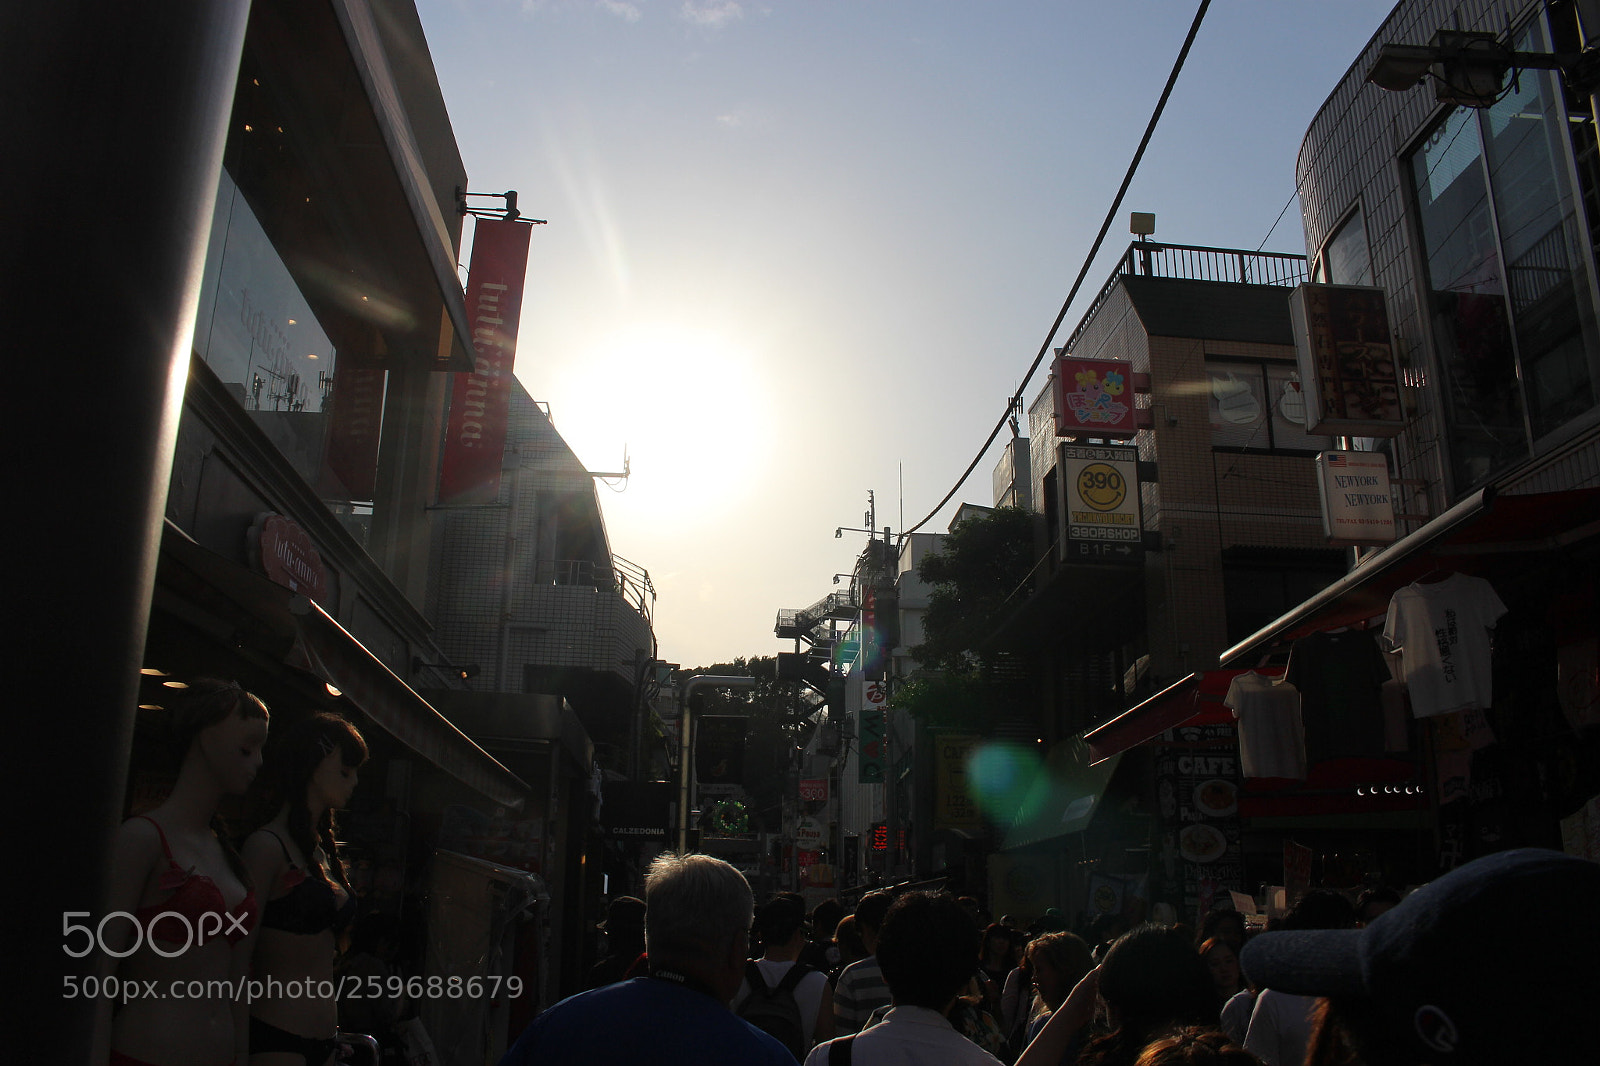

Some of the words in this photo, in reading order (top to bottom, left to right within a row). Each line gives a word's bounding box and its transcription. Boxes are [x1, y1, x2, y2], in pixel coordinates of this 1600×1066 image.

[1083, 472, 1120, 490] 390
[1071, 527, 1138, 540] 390円SHOP
[1178, 756, 1236, 775] CAFE
[612, 827, 665, 836] CALZEDONIA
[655, 969, 686, 984] Canon
